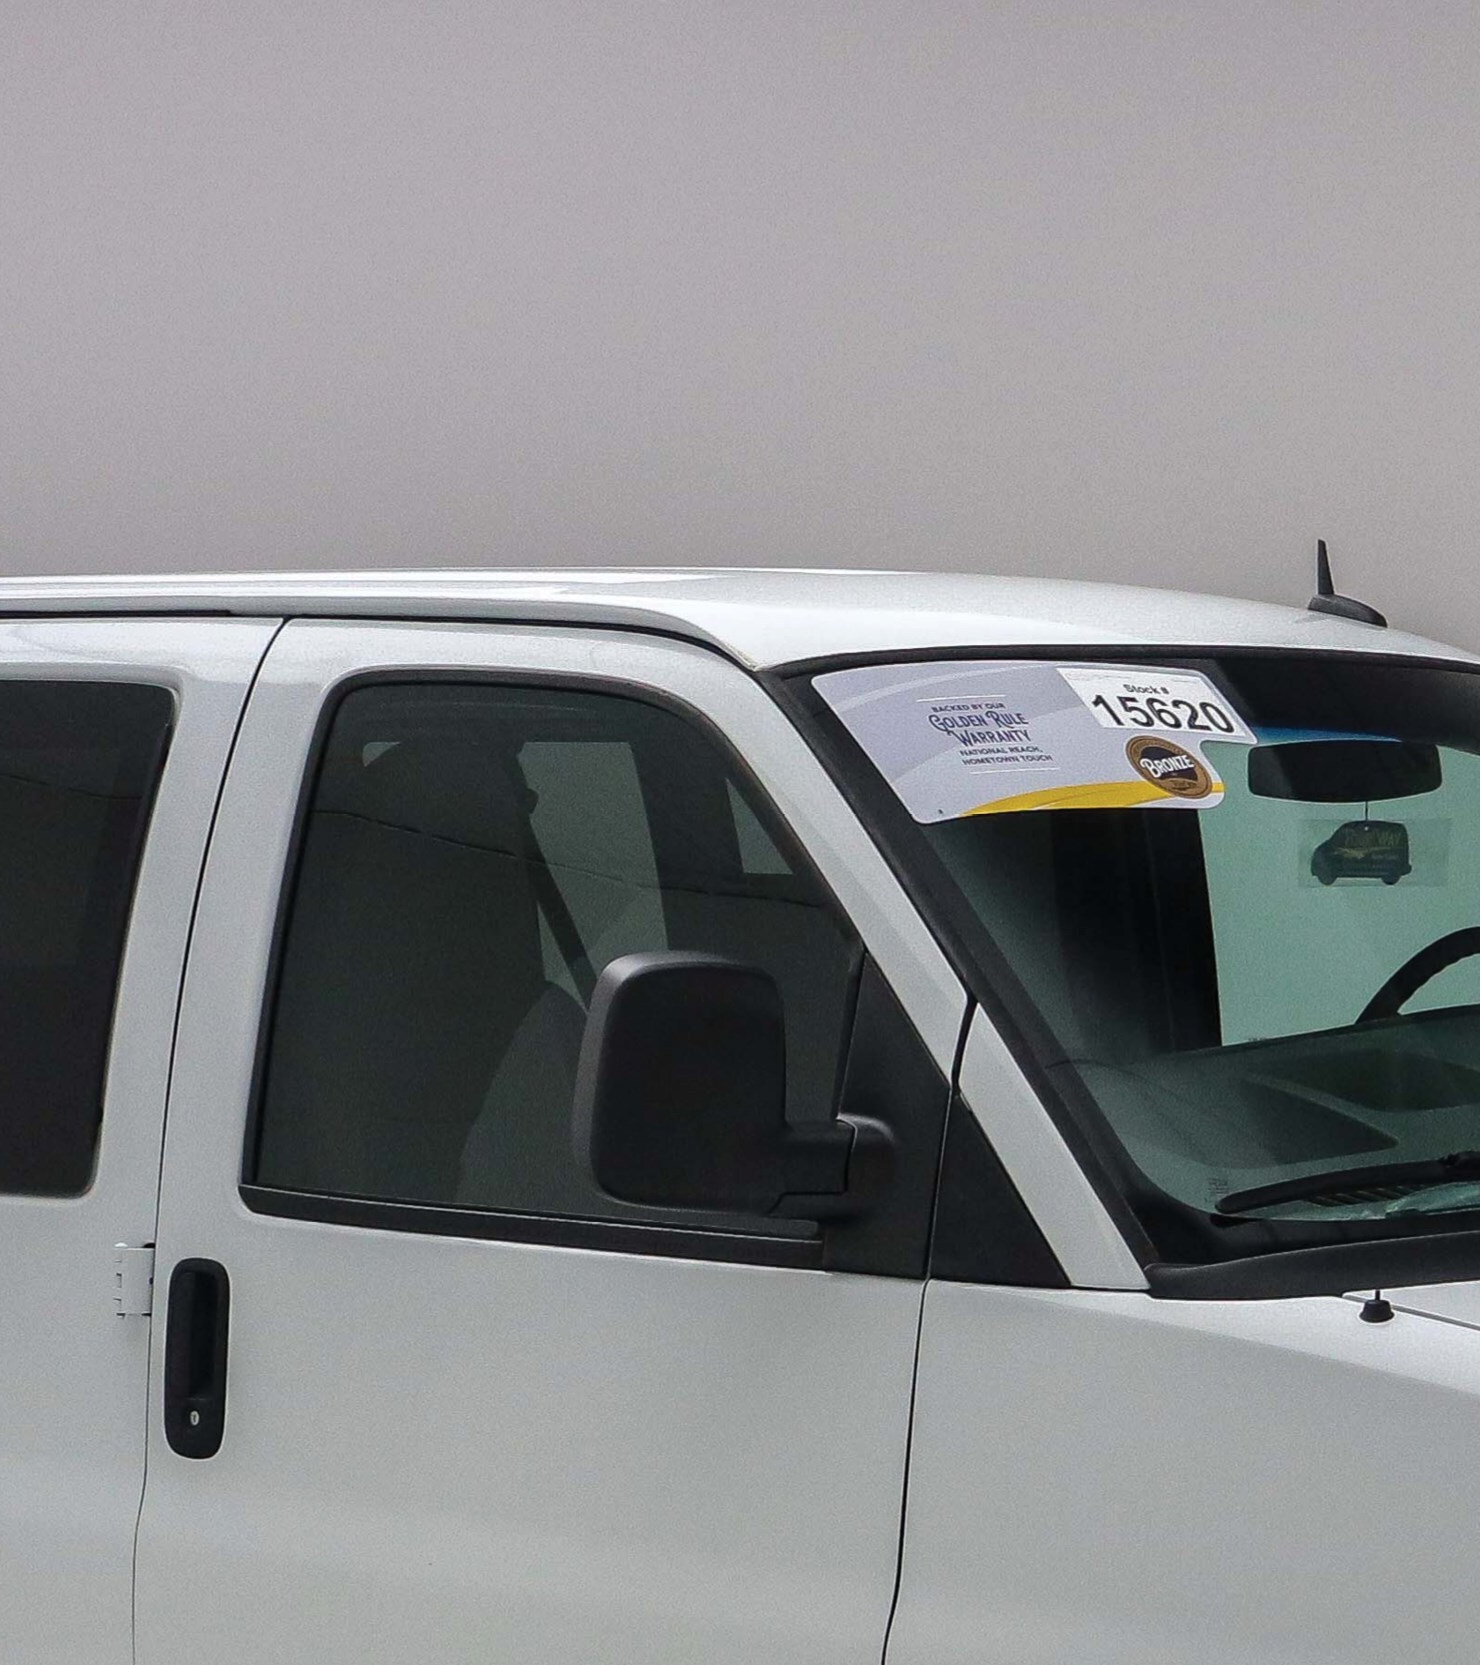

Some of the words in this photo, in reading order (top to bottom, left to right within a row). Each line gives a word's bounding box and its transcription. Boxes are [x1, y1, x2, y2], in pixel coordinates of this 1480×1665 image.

[1122, 683, 1159, 695] Stock
[931, 704, 969, 712] BACKED
[972, 703, 983, 711] BY
[985, 702, 1006, 710] OUR
[1092, 695, 1234, 733] 15620
[928, 713, 988, 732] GOLDEN
[985, 711, 1029, 729] RULE
[947, 730, 1031, 746] WARRANTY
[960, 747, 1008, 756] NATIONAL
[962, 757, 1020, 765] HOMETOWN
[1139, 754, 1196, 778] BRONZE
